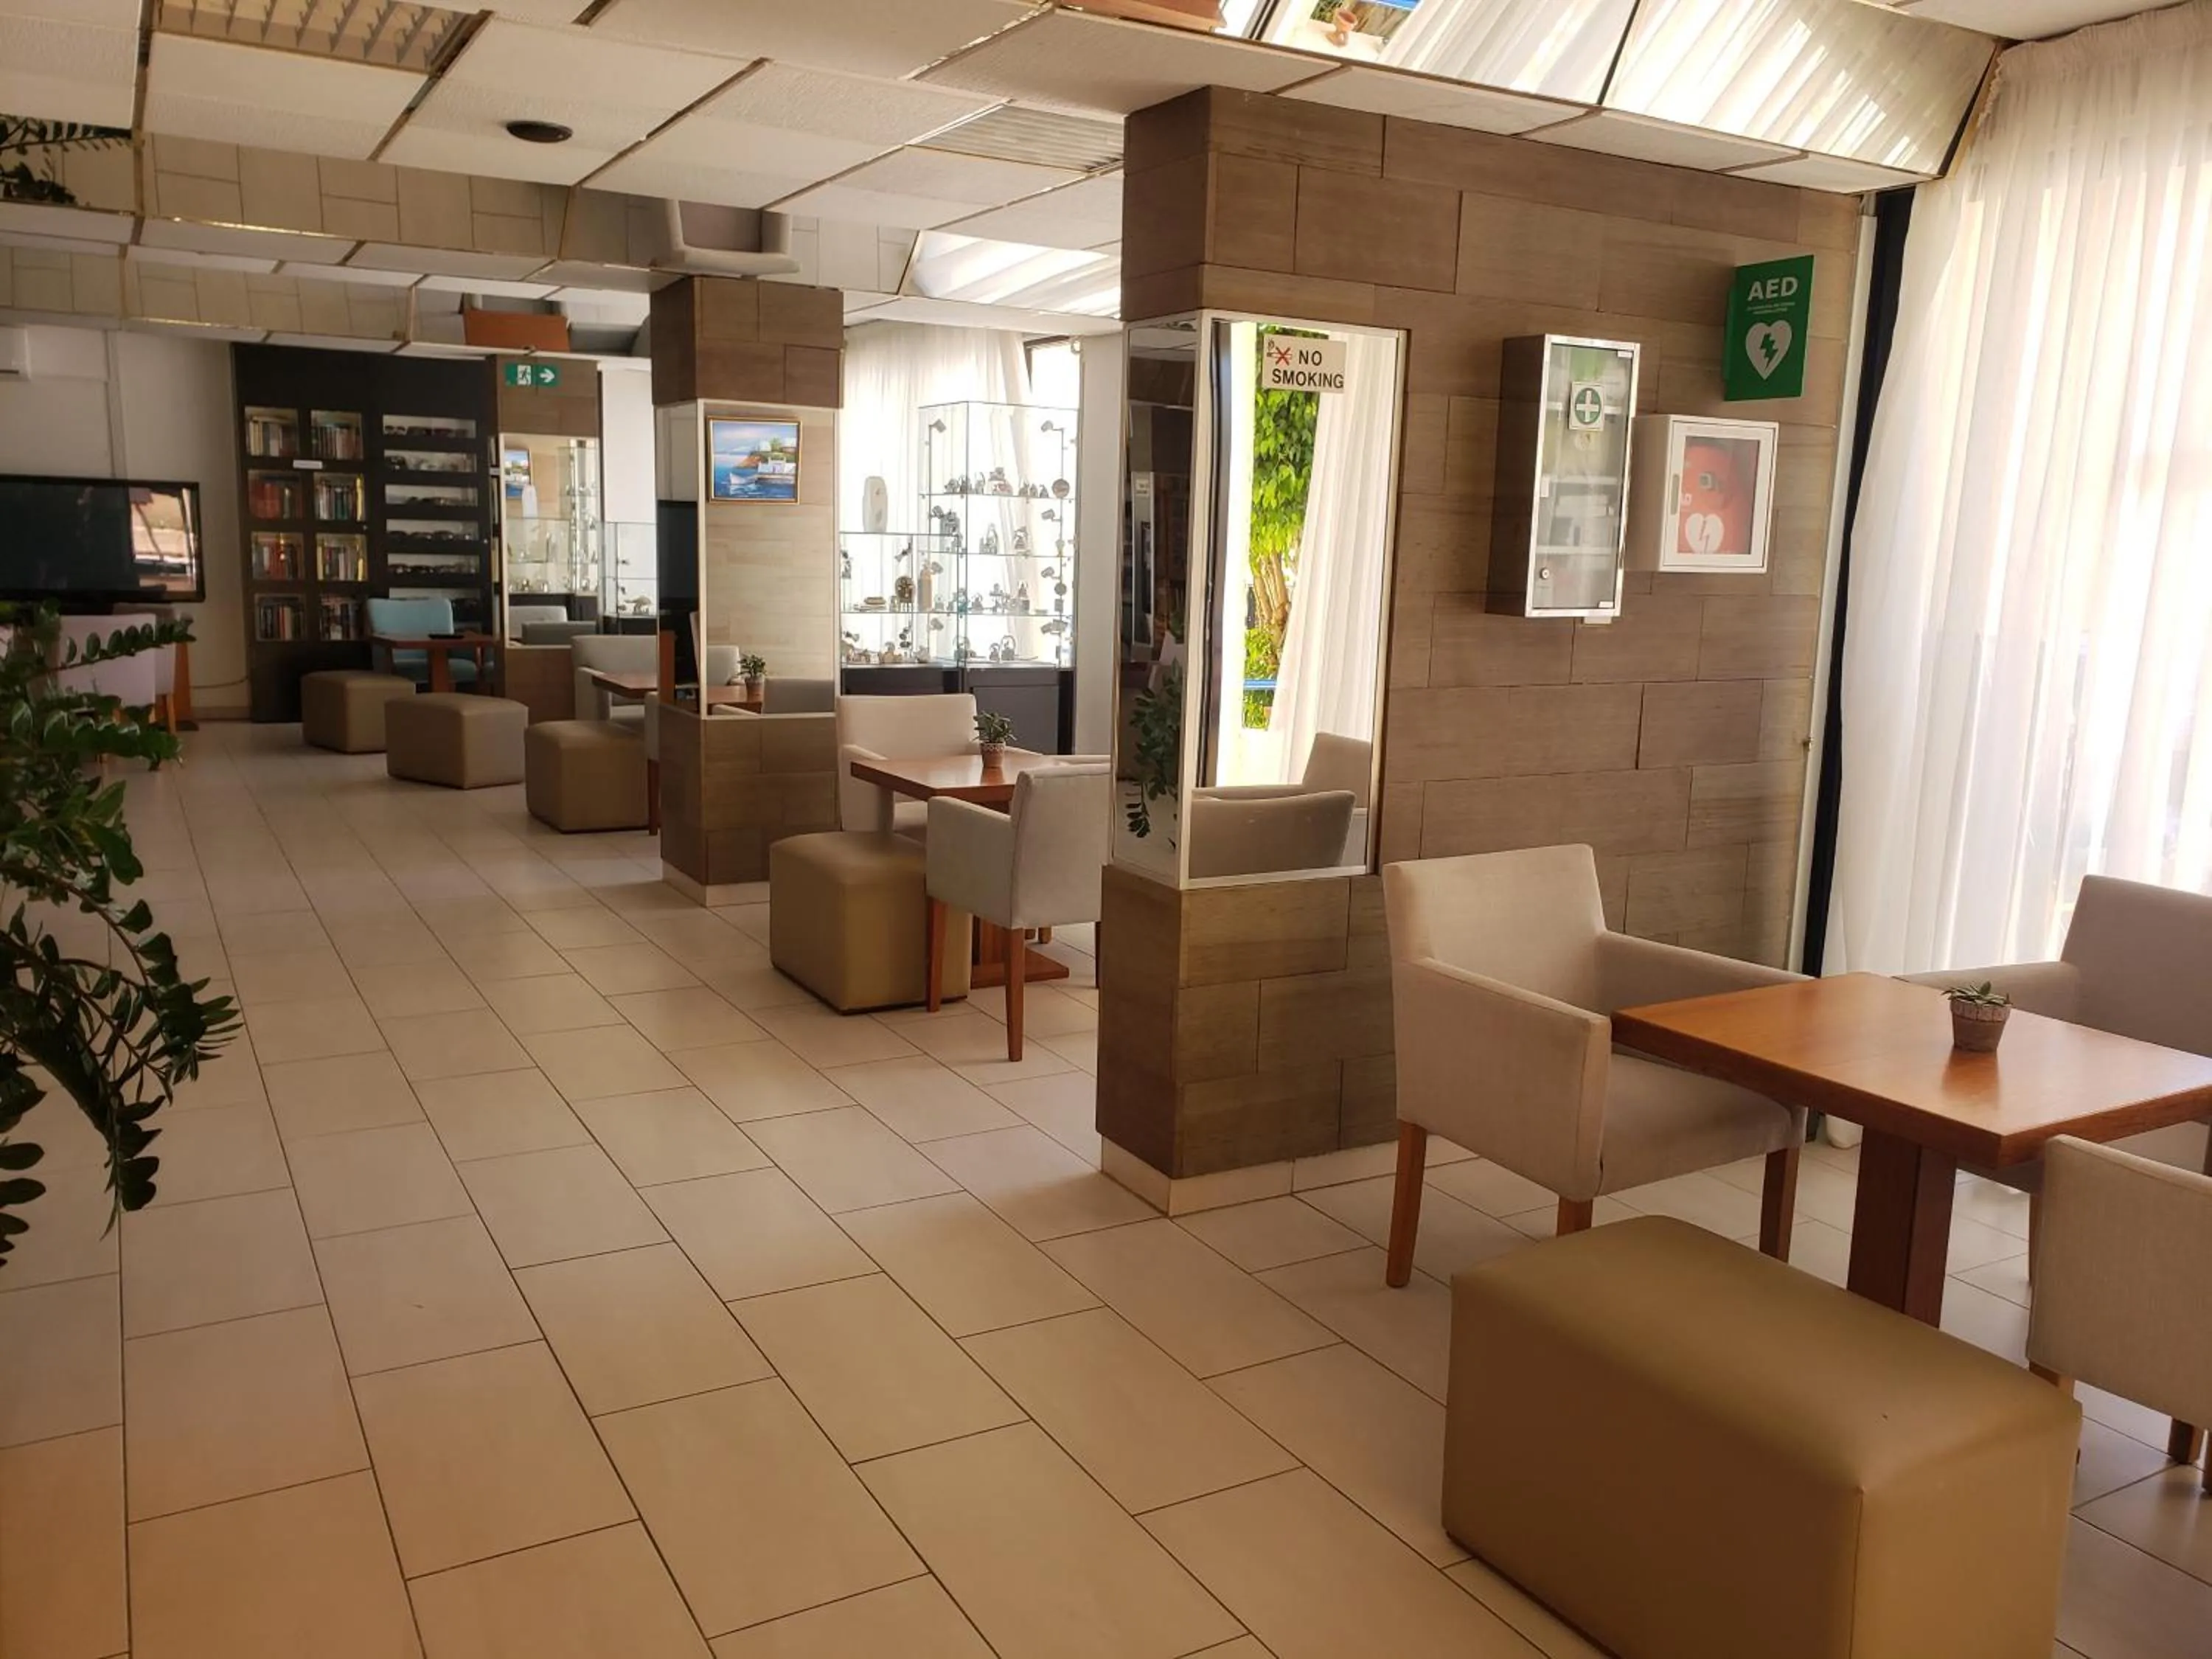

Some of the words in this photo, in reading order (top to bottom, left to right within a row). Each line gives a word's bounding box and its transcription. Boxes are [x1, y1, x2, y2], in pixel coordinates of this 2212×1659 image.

[1747, 277, 1798, 301] AED
[1298, 350, 1322, 366] NO
[1272, 369, 1344, 389] SMOKING
